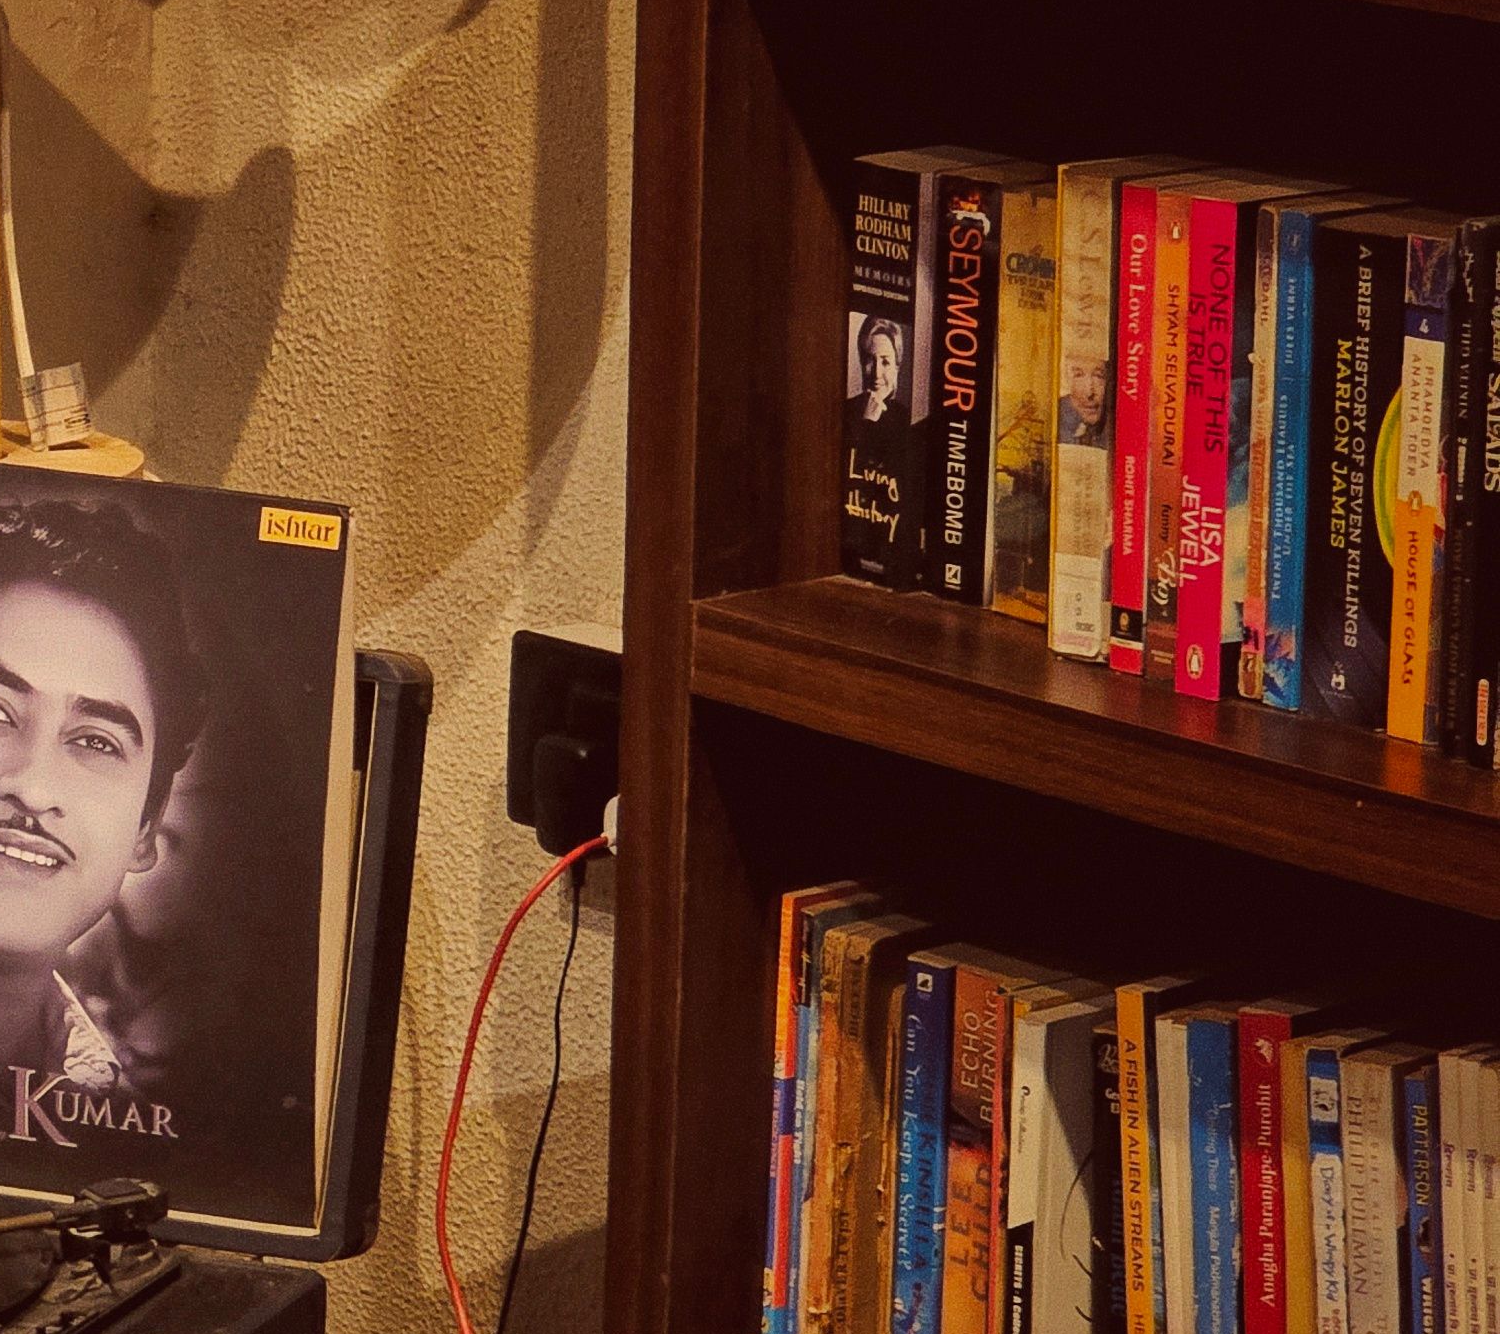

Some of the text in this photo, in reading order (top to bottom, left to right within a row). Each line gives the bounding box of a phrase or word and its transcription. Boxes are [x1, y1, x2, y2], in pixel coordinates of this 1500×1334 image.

[854, 213, 912, 244] RODHAM
[855, 235, 910, 264] CLINTON
[856, 193, 911, 224] HILLARY
[1122, 233, 1148, 401] Our Love Story
[942, 224, 983, 545] SEYMOUR TIMEBOMB
[1161, 284, 1181, 466] SHYAM SELVADURAI
[1329, 339, 1354, 550] MARLON JAMES
[1343, 246, 1373, 648] A BRIEF HISTORY OF SEVEN KILLINGS
[265, 511, 335, 545] ishtar
[1122, 454, 1137, 555] ROHIT SHARMA
[1177, 475, 1202, 588] JEWELL
[1199, 506, 1224, 566] LISA
[961, 1011, 980, 1089] ECHO
[979, 988, 1000, 1124] BURNING
[1125, 1038, 1146, 1292] A FISH IN ALIEN STREAMS
[1411, 1103, 1431, 1206] PATTERSON
